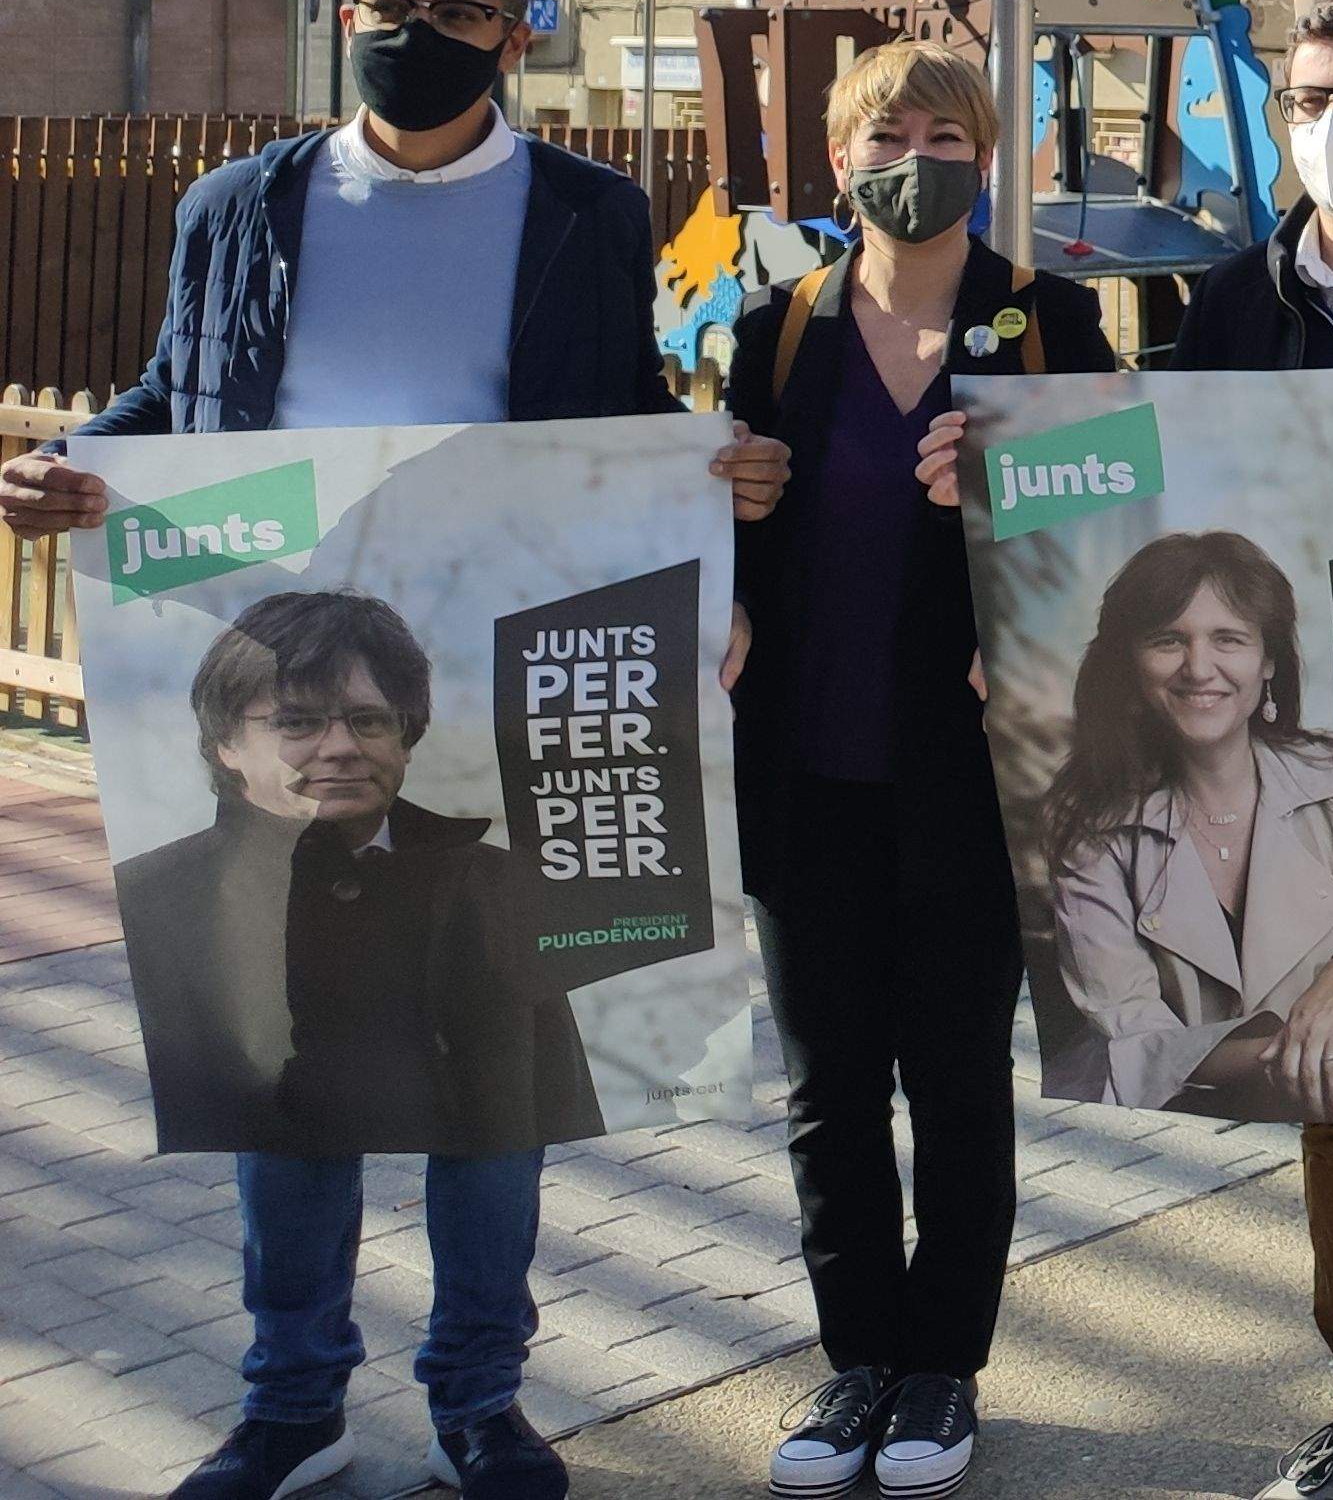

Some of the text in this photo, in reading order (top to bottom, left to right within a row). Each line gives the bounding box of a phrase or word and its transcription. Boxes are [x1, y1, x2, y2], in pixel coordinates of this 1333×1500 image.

[1000, 453, 1136, 510] junts
[122, 513, 285, 575] junts
[522, 625, 656, 662] JUNTS
[526, 660, 659, 714] PER
[527, 713, 668, 761] FER.
[529, 765, 661, 796] JUNTS
[536, 794, 668, 837] PER
[540, 837, 682, 881] SER.
[538, 924, 689, 951] PUIGDEMONT
[613, 914, 688, 928] PRESIDENT
